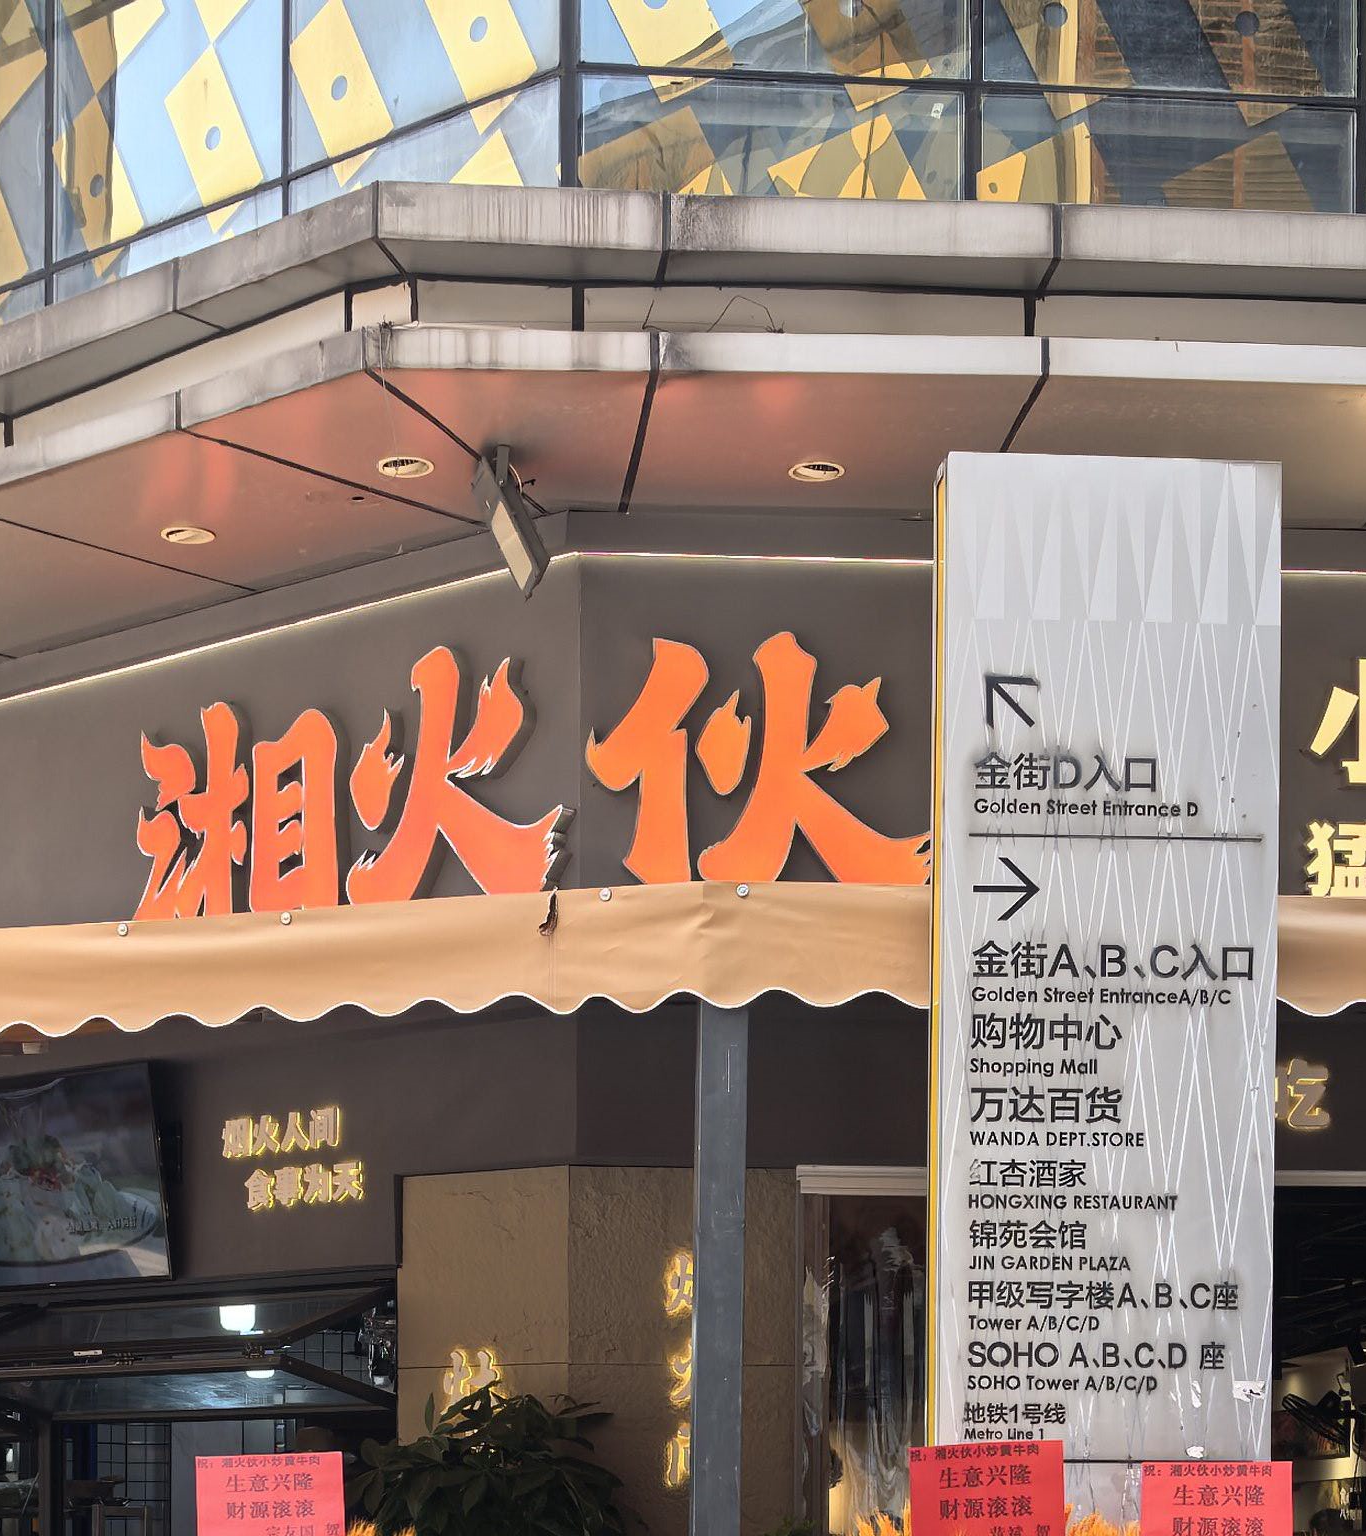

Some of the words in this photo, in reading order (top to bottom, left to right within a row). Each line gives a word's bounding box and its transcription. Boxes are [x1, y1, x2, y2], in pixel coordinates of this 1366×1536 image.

[133, 628, 931, 922] 湘火伙
[974, 751, 1158, 793] 金街D入口
[974, 798, 1041, 815] Golden
[1046, 799, 1097, 816] Street
[1102, 800, 1181, 818] Entrance
[1186, 802, 1199, 818] D
[972, 940, 1255, 981] 金街A、B、C入口
[971, 986, 1038, 1003] Golden
[1043, 987, 1095, 1004] Street
[970, 1012, 1123, 1051] 购物中心
[970, 1058, 1054, 1076] Shopping
[1059, 1058, 1098, 1074] Mall
[970, 1086, 1123, 1124] 万达百货
[969, 1131, 1039, 1147] WANDA
[1046, 1132, 1145, 1147] DEPT.STORE
[969, 1159, 1087, 1189] 红杏酒家
[968, 1195, 1067, 1211] HONGXING
[1073, 1195, 1179, 1212] RESTAURANT
[969, 1220, 1088, 1250] 锦苑会馆
[968, 1256, 995, 1272] JIN
[1001, 1256, 1073, 1272] GARDEN
[1079, 1256, 1131, 1272] PLAZA
[968, 1281, 1239, 1311] 甲级写字楼A、B、C座
[968, 1315, 1021, 1332] Tower
[1026, 1315, 1100, 1332] A/B/C/D
[967, 1342, 1060, 1369] SOHO
[1199, 1342, 1226, 1371] 座
[967, 1376, 1021, 1392] SOHO
[1026, 1376, 1079, 1392] Tower
[1085, 1376, 1158, 1393] A/B/C/D
[964, 1402, 1066, 1424] 地铁1号线
[964, 1428, 1003, 1440] Metro
[1008, 1428, 1034, 1440] Line
[1039, 1428, 1044, 1440] 1
[226, 1473, 315, 1493] 生意兴隆
[939, 1463, 1033, 1490] 生意兴隆
[1172, 1484, 1266, 1507] 生意兴隆
[226, 1499, 316, 1520] 财源滚滚
[939, 1495, 1034, 1521] 财源滚滚
